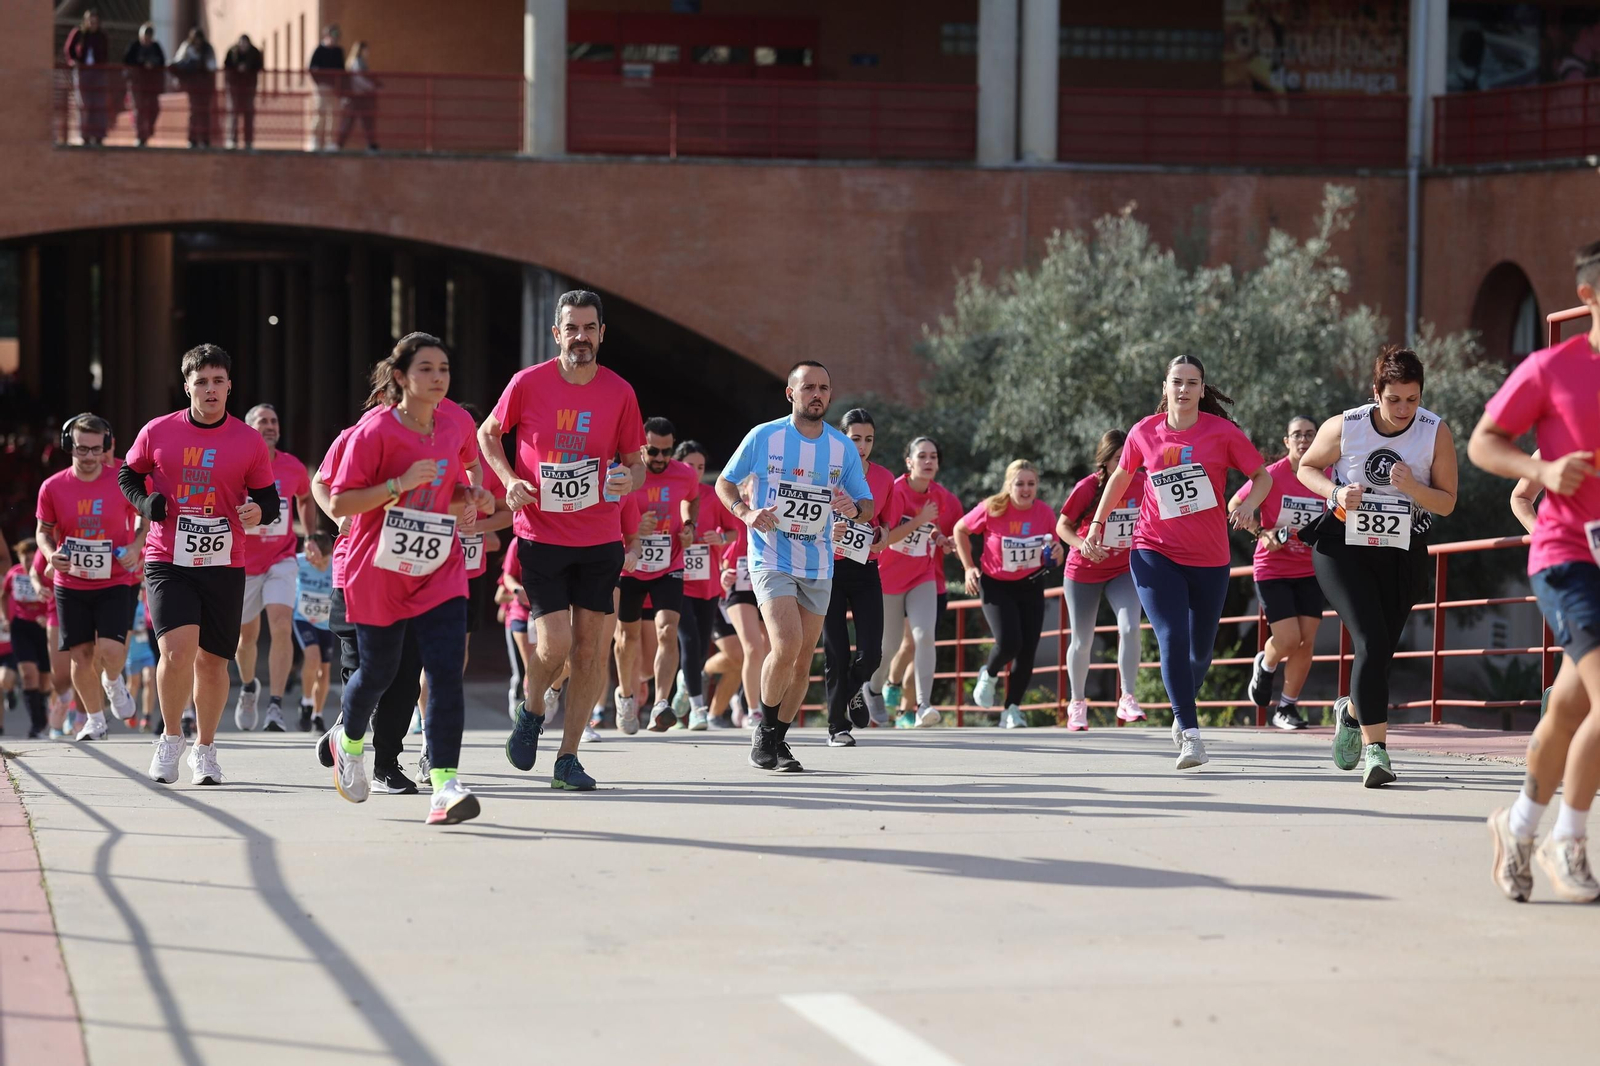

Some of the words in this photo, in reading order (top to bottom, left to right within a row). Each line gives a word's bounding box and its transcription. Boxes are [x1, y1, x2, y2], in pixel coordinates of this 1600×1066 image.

[1270, 67, 1300, 89] de
[1305, 67, 1397, 95] málaga
[557, 409, 592, 433] WE
[556, 434, 585, 451] RUN
[183, 447, 217, 468] WE
[1163, 446, 1194, 465] WE
[184, 469, 209, 483] RUN
[431, 459, 448, 486] E
[543, 470, 571, 478] UMA
[1154, 473, 1179, 485] UMA
[177, 484, 216, 505] UMA
[551, 476, 590, 498] 405
[647, 486, 670, 502] WE
[780, 489, 804, 499] UMA
[1171, 480, 1198, 502] 95
[77, 499, 103, 516] WE
[783, 500, 822, 521] 249
[1285, 501, 1303, 510] UMA
[1358, 503, 1378, 511] MA
[180, 523, 205, 533] UMA
[389, 518, 420, 531] UMA
[1009, 521, 1031, 535] WE
[1118, 522, 1134, 537] 11
[1357, 513, 1400, 535] 382
[185, 534, 224, 553] 586
[784, 532, 817, 543] unicaja
[835, 530, 865, 549] 98
[68, 544, 88, 552] UMA
[391, 532, 441, 560] 348
[73, 553, 104, 568] 163
[1010, 549, 1035, 563] 111
[304, 605, 329, 616] 694
